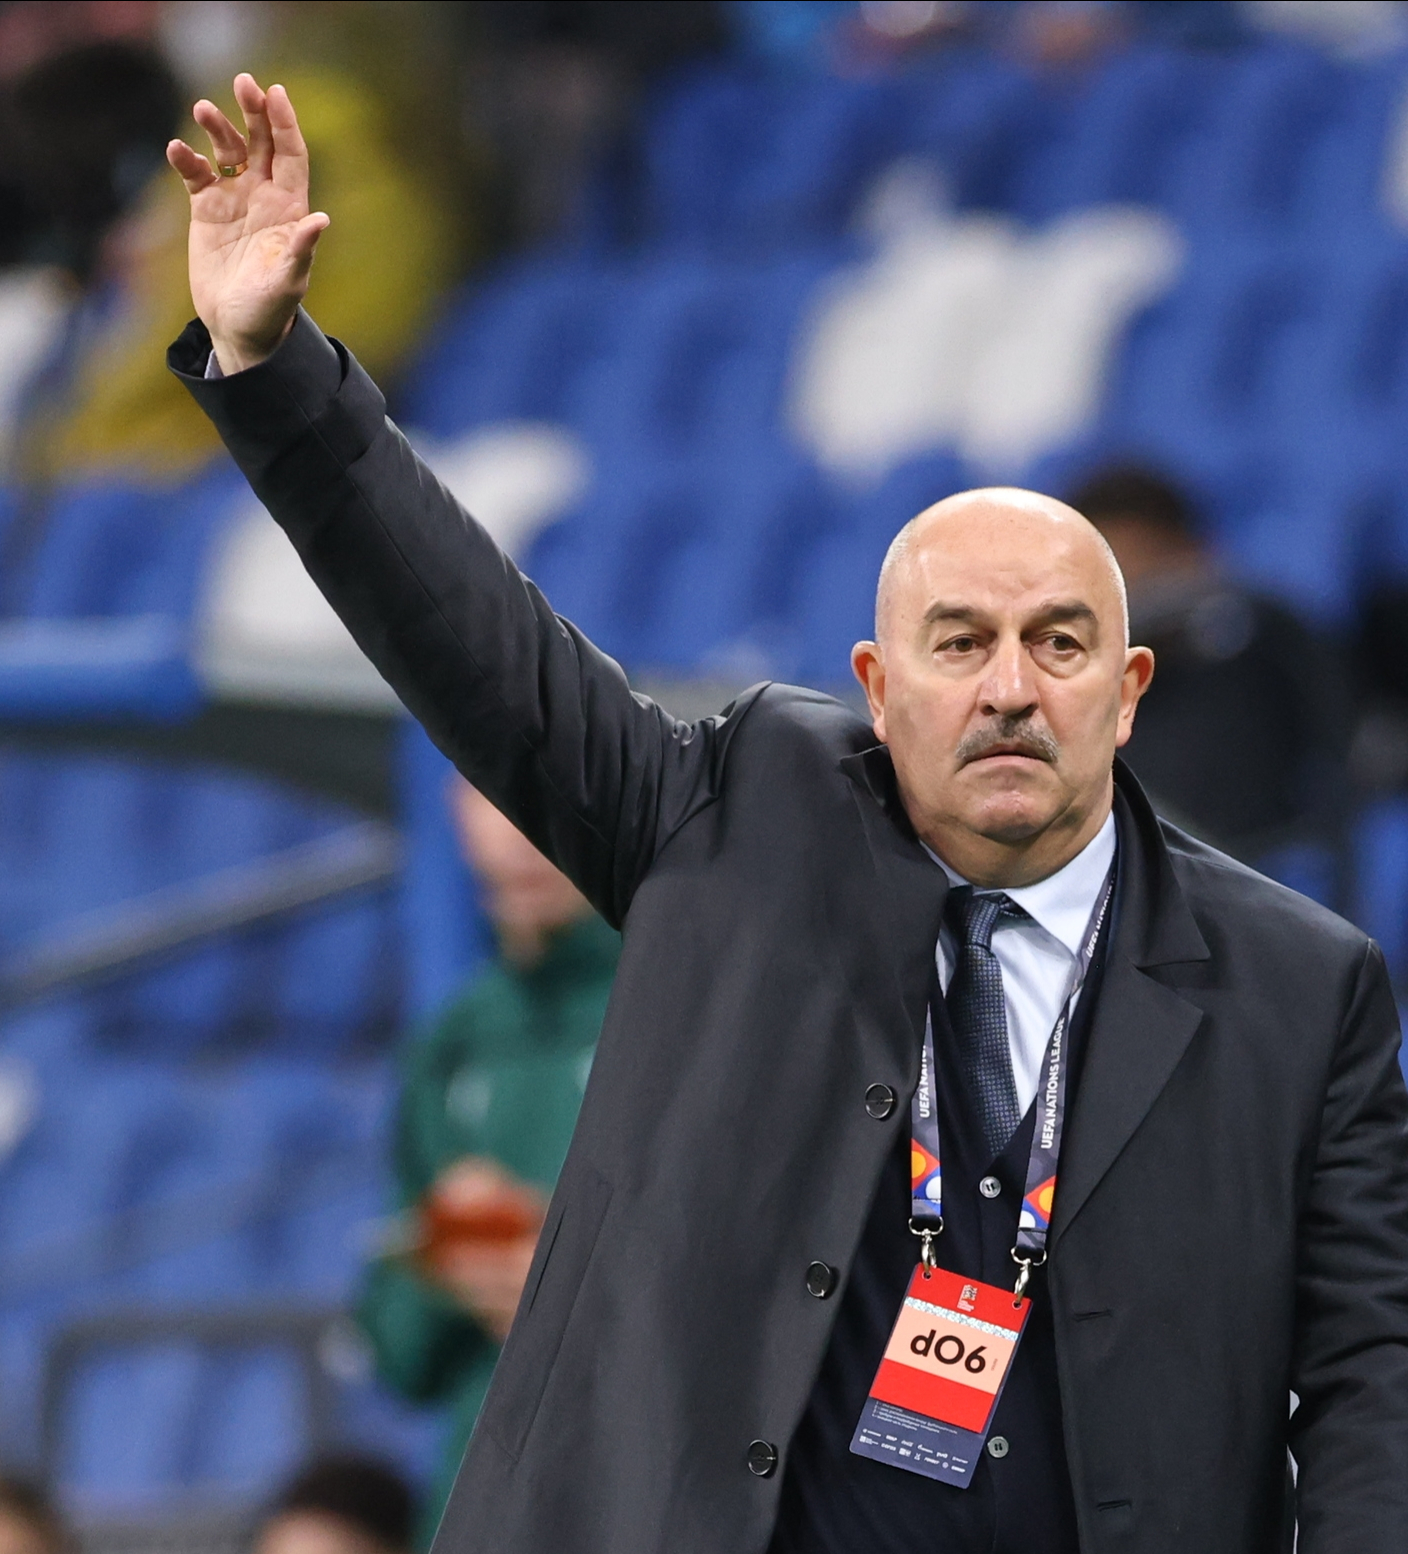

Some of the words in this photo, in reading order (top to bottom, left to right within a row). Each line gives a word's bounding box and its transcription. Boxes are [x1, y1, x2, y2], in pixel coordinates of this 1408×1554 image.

[1050, 1017, 1065, 1063] LEAGUE
[919, 1086, 930, 1118] UEFA
[1045, 1064, 1060, 1118] NATIONS
[1040, 1118, 1056, 1149] UEFA
